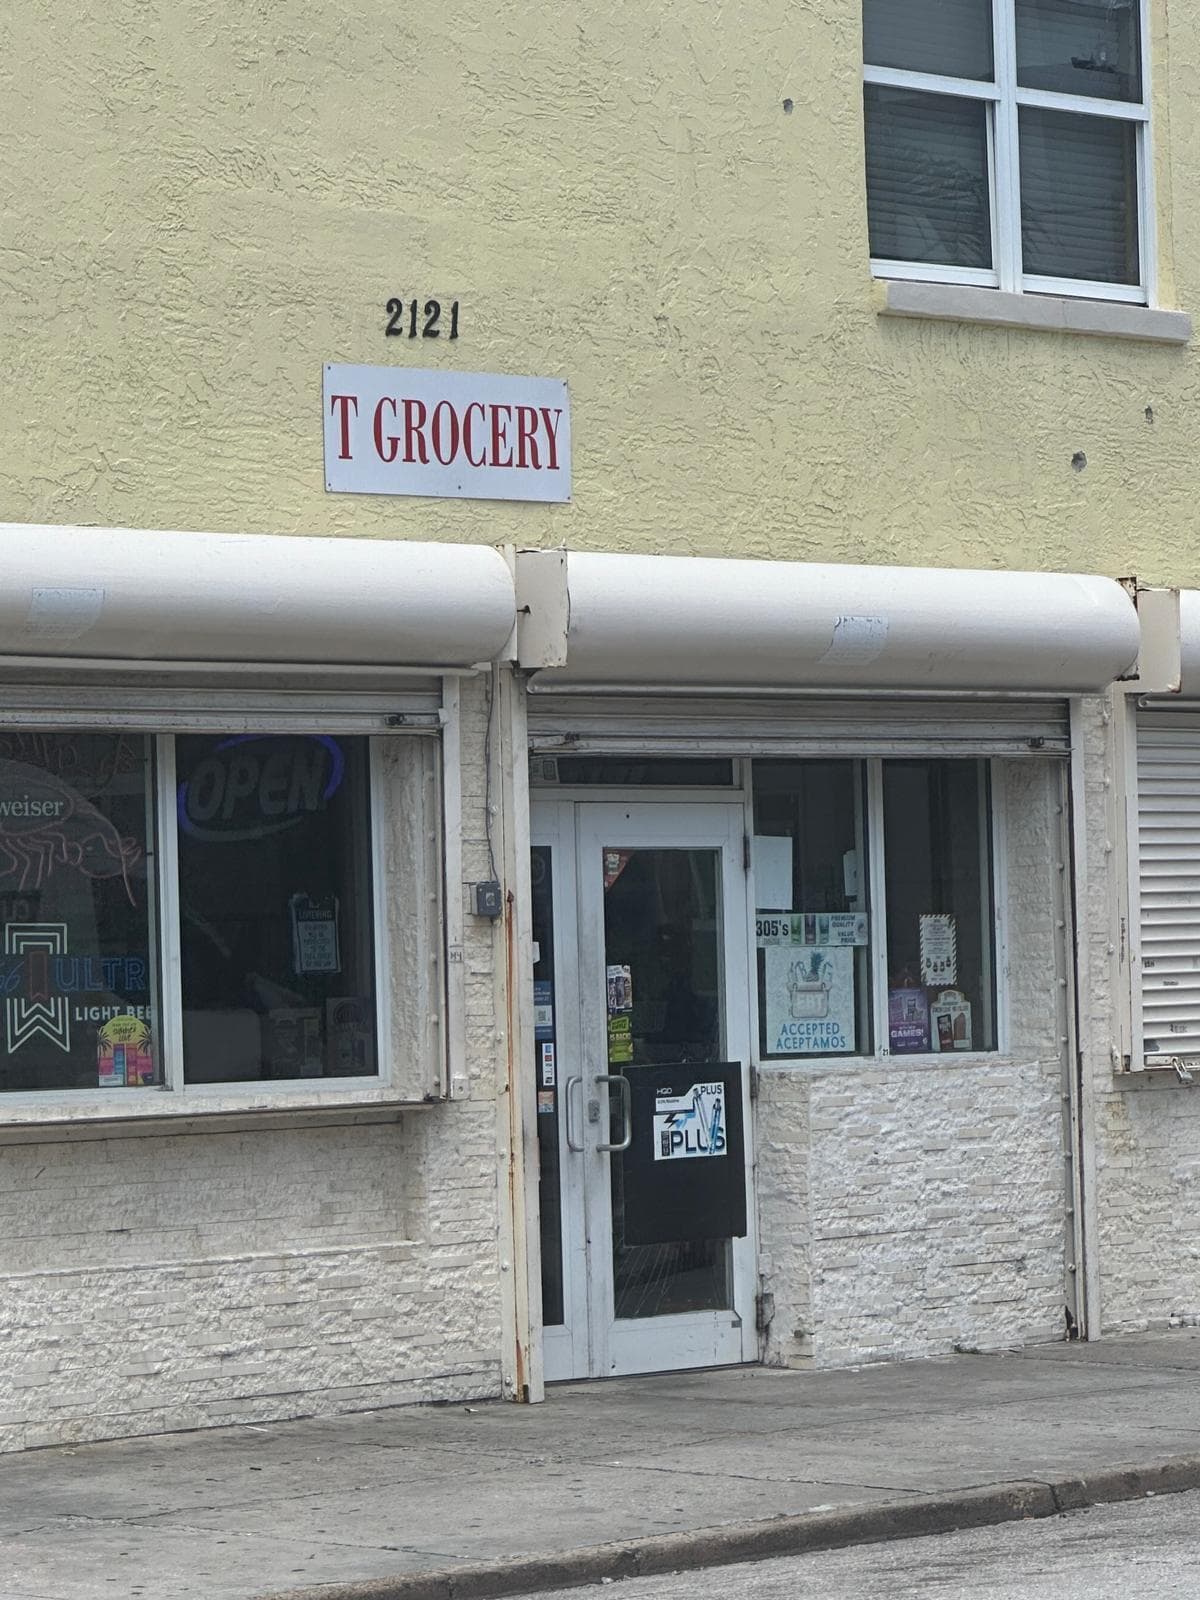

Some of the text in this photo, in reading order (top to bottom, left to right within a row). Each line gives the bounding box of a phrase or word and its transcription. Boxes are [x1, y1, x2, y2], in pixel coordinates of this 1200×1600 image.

[385, 298, 459, 340] 2121
[331, 395, 563, 470] T GROCERY
[187, 750, 328, 821] OPEN
[0, 795, 64, 817] weiser
[75, 1006, 120, 1021] LIGHT
[781, 1022, 840, 1036] ACCEPTED
[891, 1028, 924, 1038] GAMES!
[776, 1036, 846, 1049] ACEPTAMOS
[700, 1084, 722, 1095] PLUS
[670, 1126, 725, 1153] PLUS
